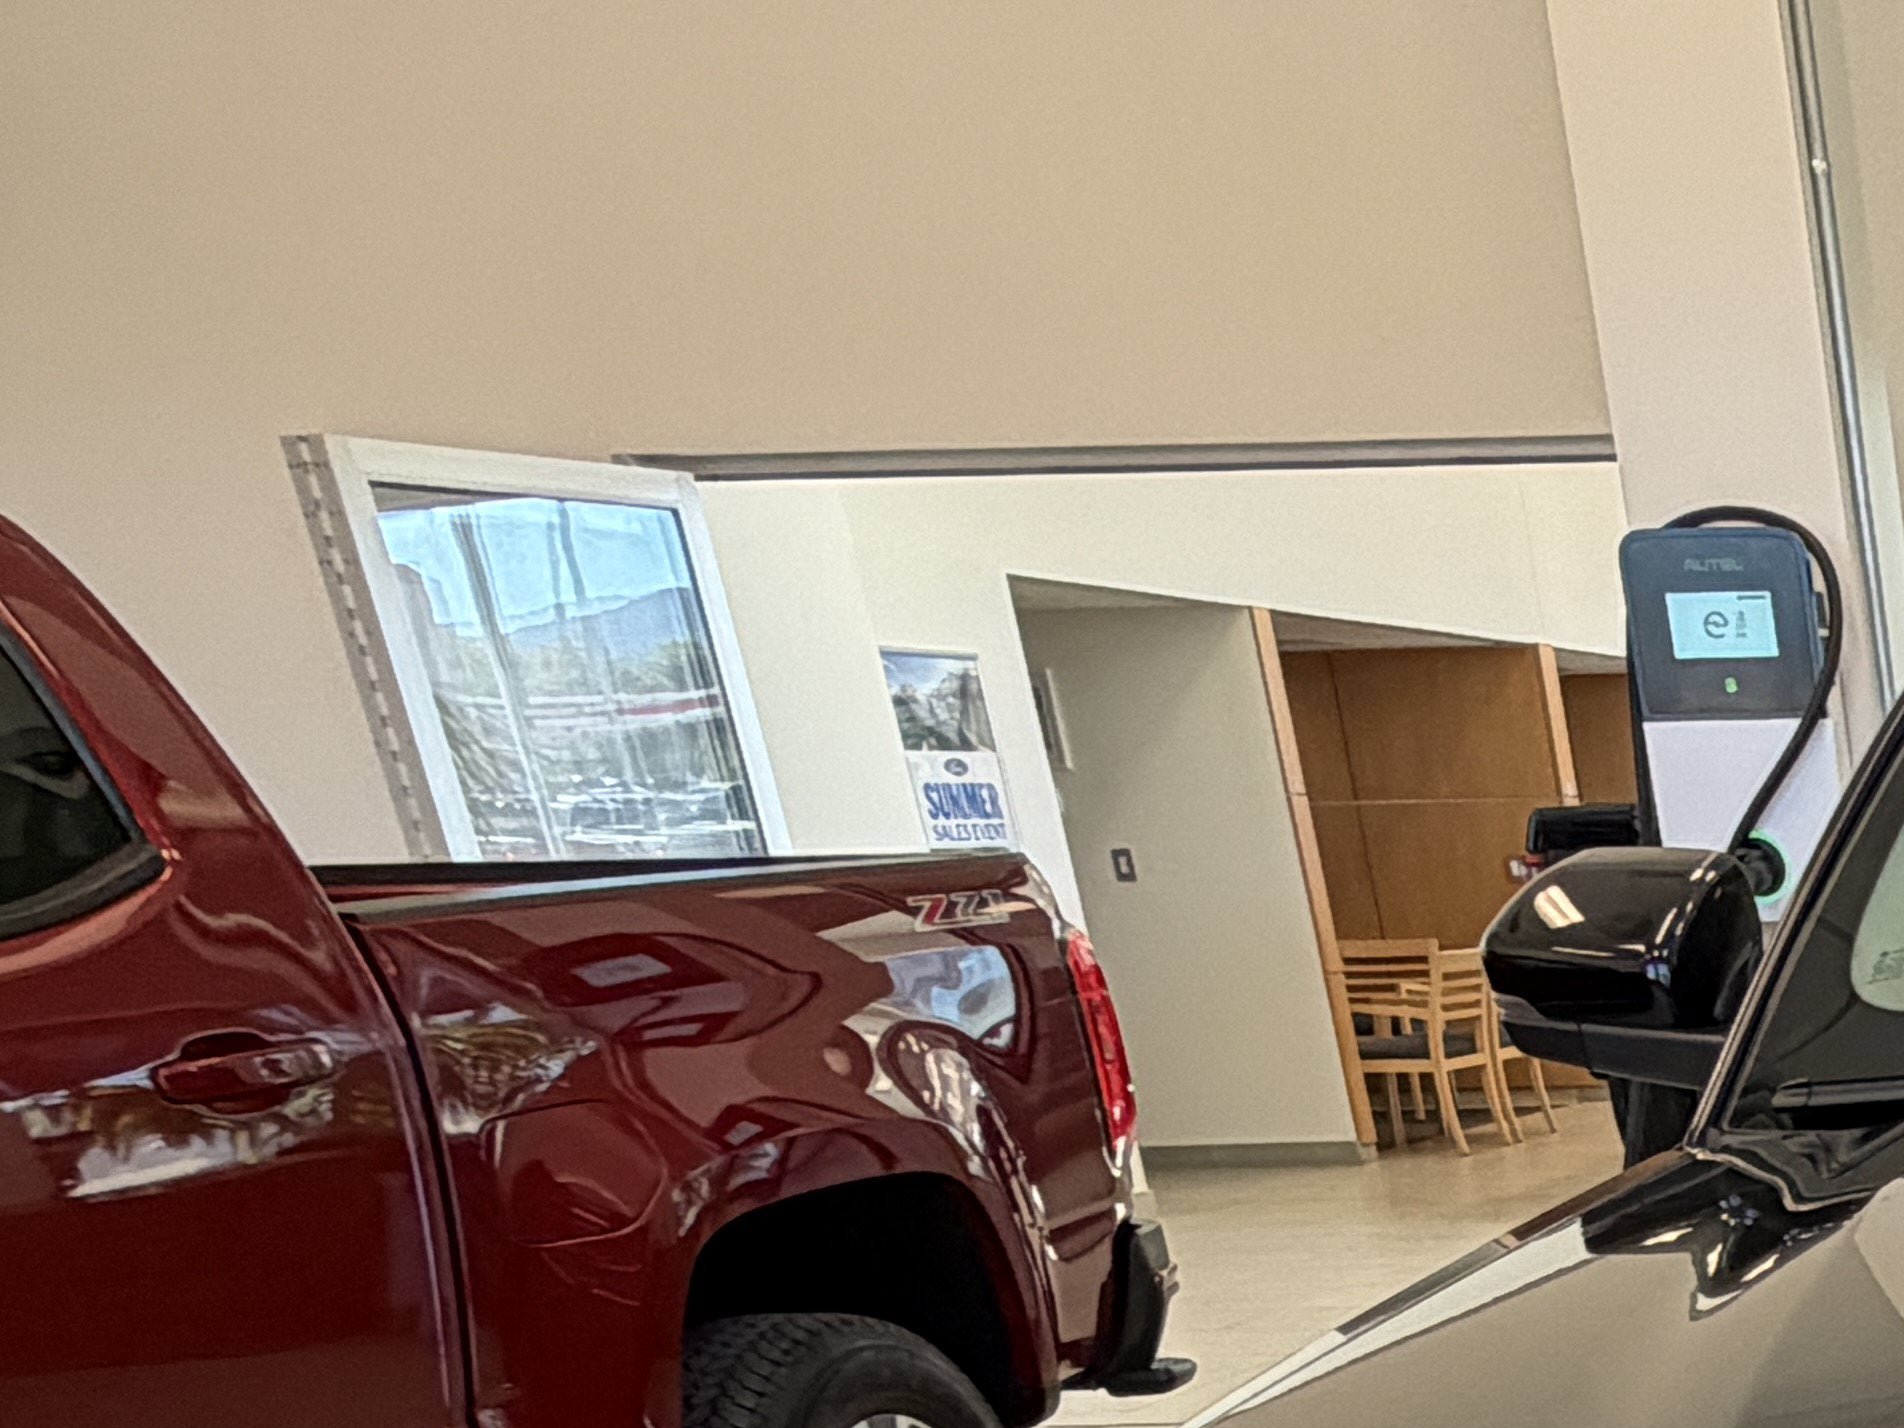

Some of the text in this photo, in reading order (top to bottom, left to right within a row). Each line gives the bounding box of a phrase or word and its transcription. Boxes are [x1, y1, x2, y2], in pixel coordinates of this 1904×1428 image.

[1684, 558, 1744, 572] AUTEL
[923, 782, 1004, 820] SUMMER
[932, 822, 1007, 841] SALES EVENT
[906, 889, 1011, 932] Z71
